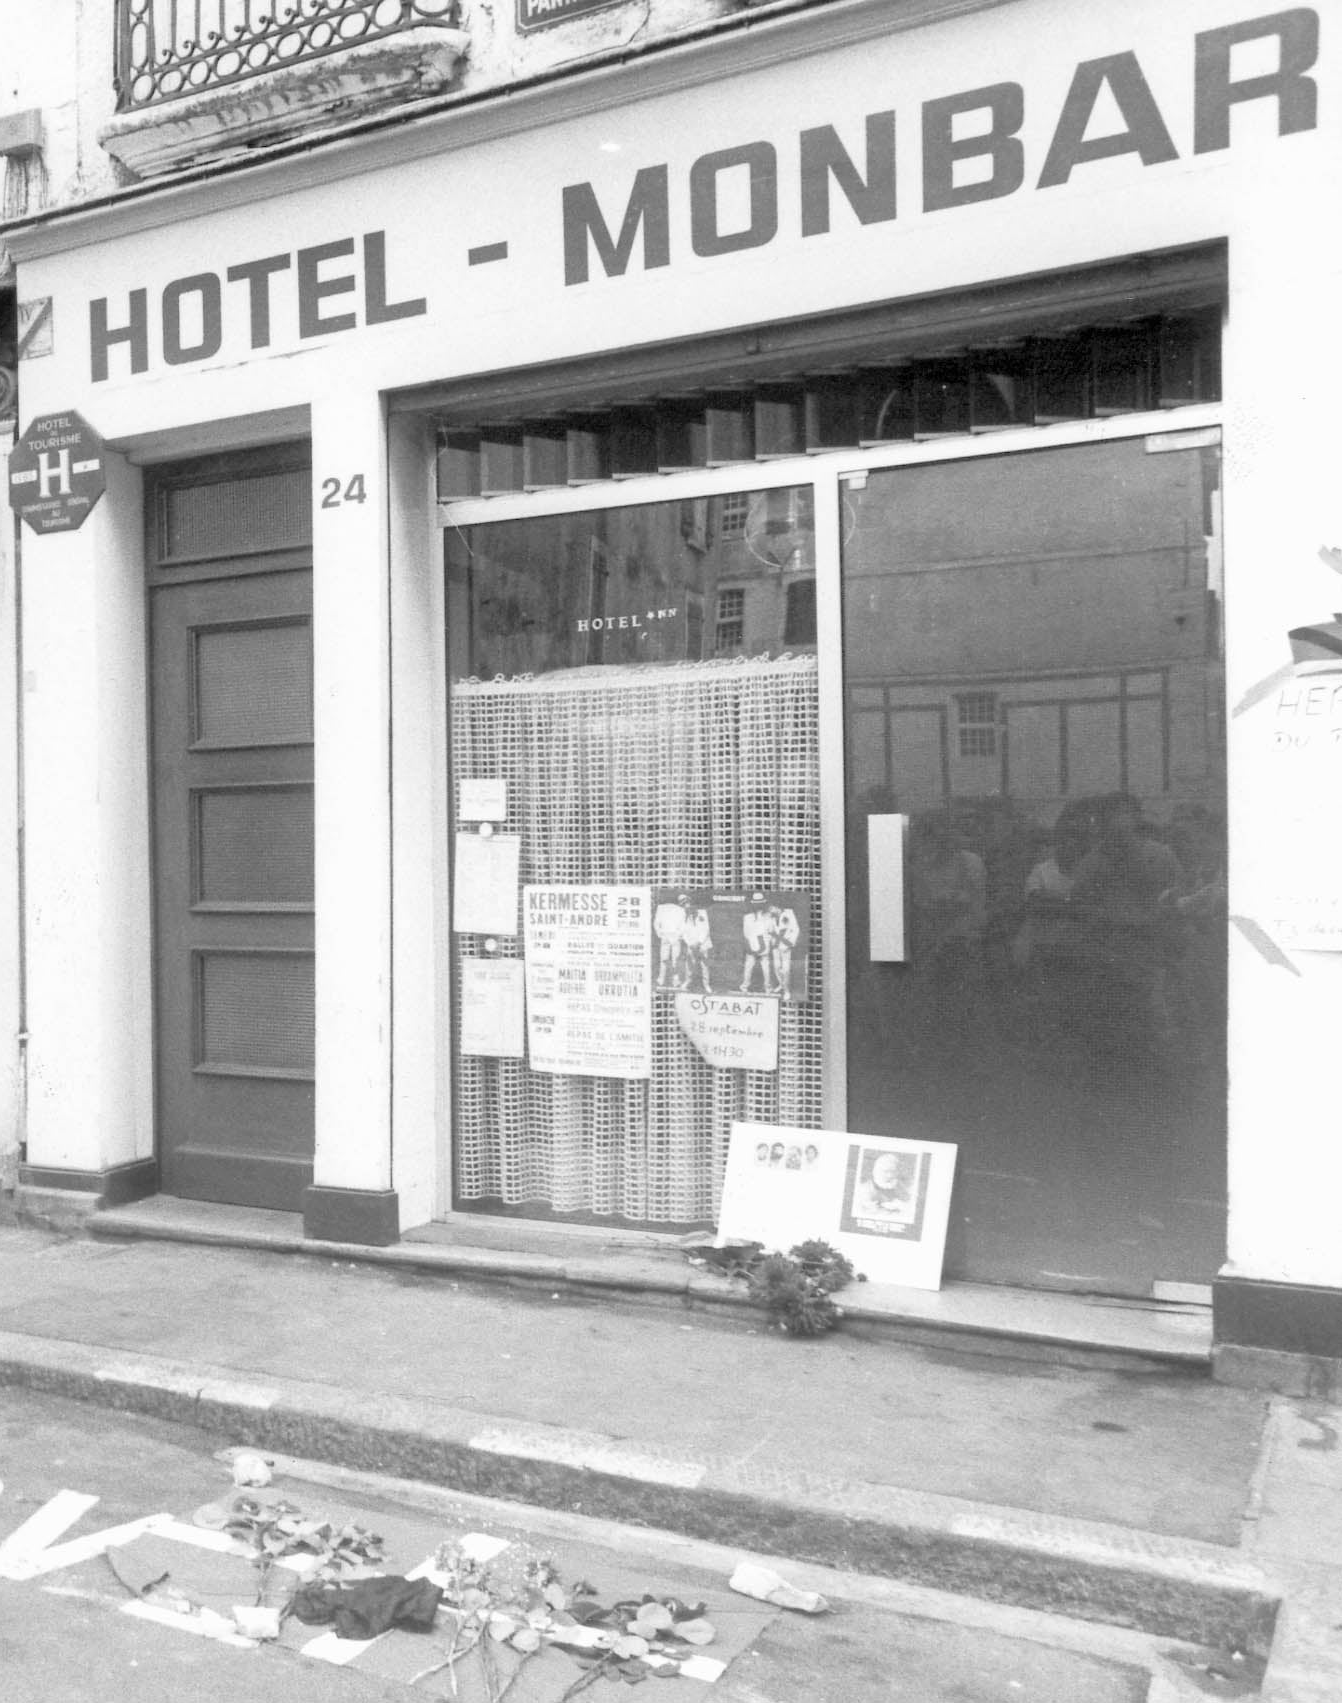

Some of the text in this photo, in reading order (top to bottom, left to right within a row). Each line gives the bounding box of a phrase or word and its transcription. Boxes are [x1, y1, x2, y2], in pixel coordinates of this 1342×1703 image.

[89, 230, 427, 383] HOTEL
[562, 7, 1320, 287] MONBAR
[28, 433, 82, 451] TOURISME
[38, 449, 72, 498] H
[321, 473, 367, 509] 24
[577, 615, 642, 632] HOTEL
[529, 893, 640, 911] KERMESSE 28
[529, 913, 609, 926] SAINT-ANDRE
[618, 909, 640, 918] 29
[691, 996, 763, 1016] OSTABAT
